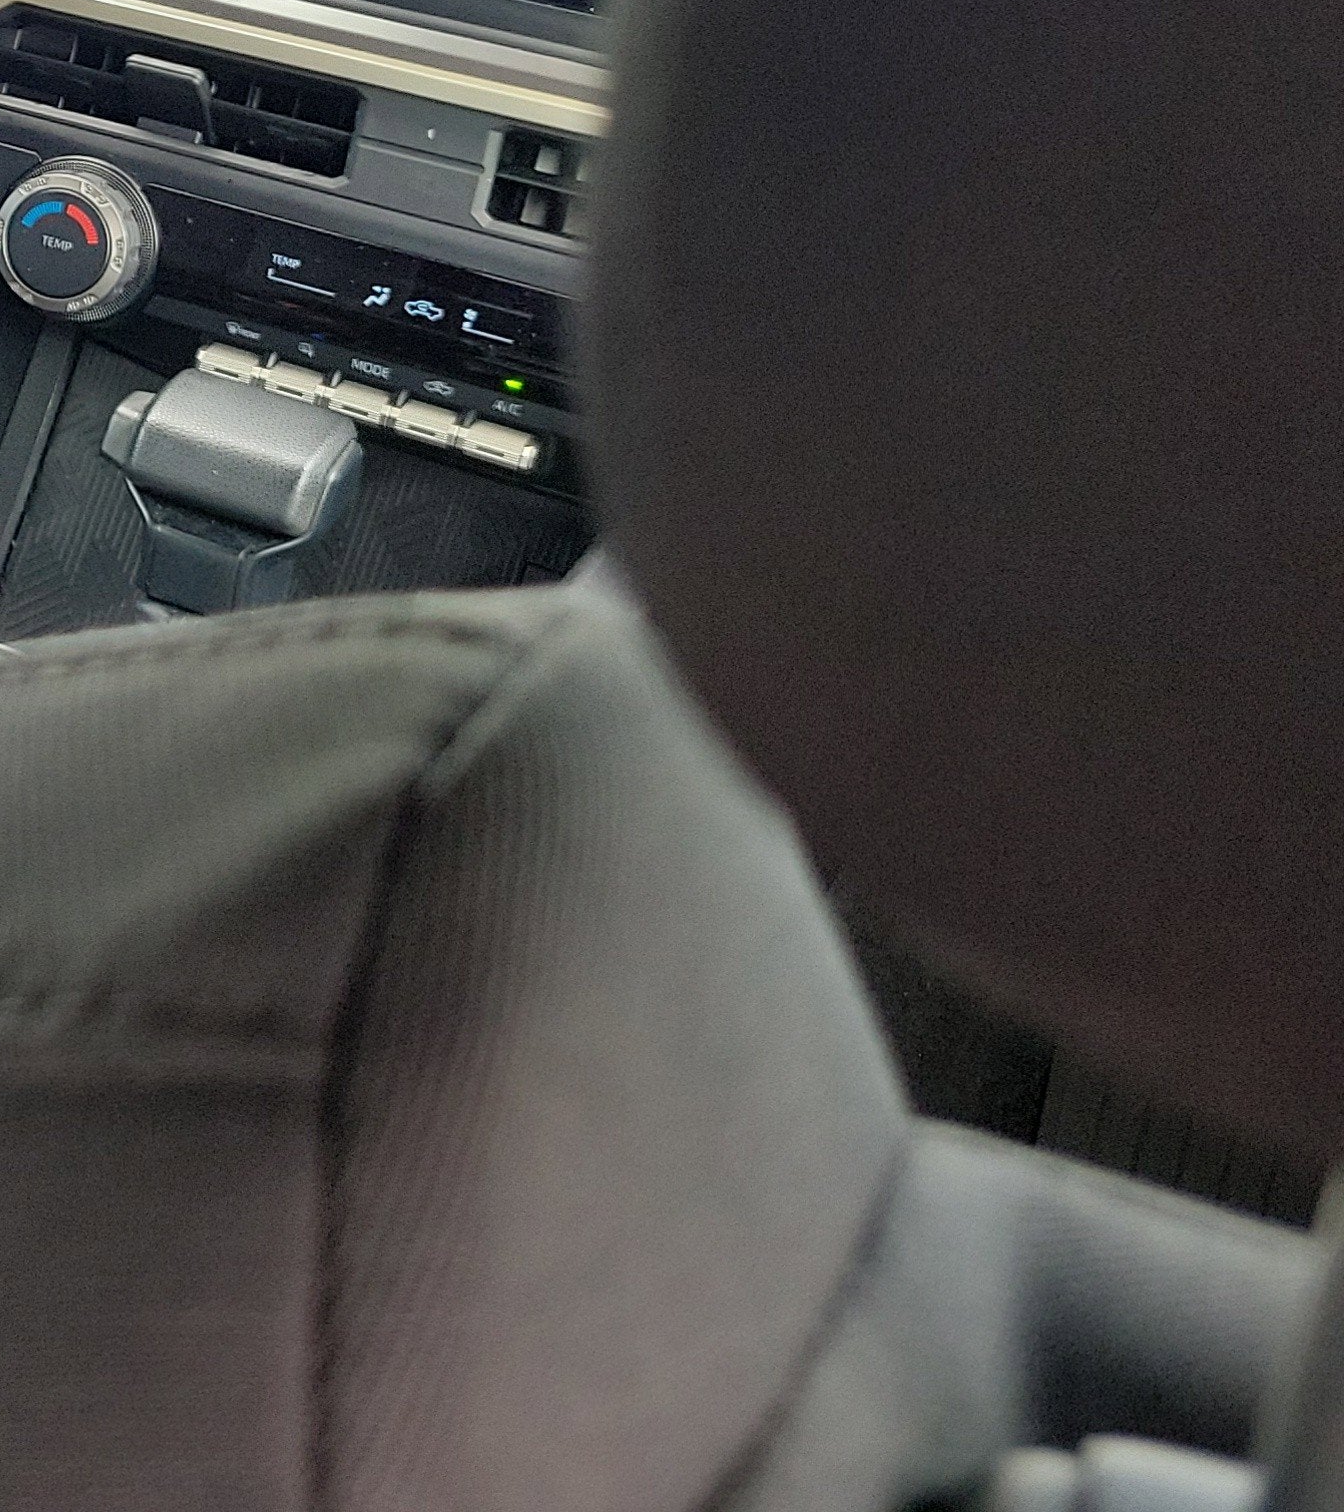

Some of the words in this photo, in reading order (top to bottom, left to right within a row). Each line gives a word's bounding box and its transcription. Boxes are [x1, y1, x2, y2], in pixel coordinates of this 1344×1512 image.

[41, 235, 73, 252] TEMP
[271, 253, 301, 270] TEMP
[351, 357, 390, 380] MODE
